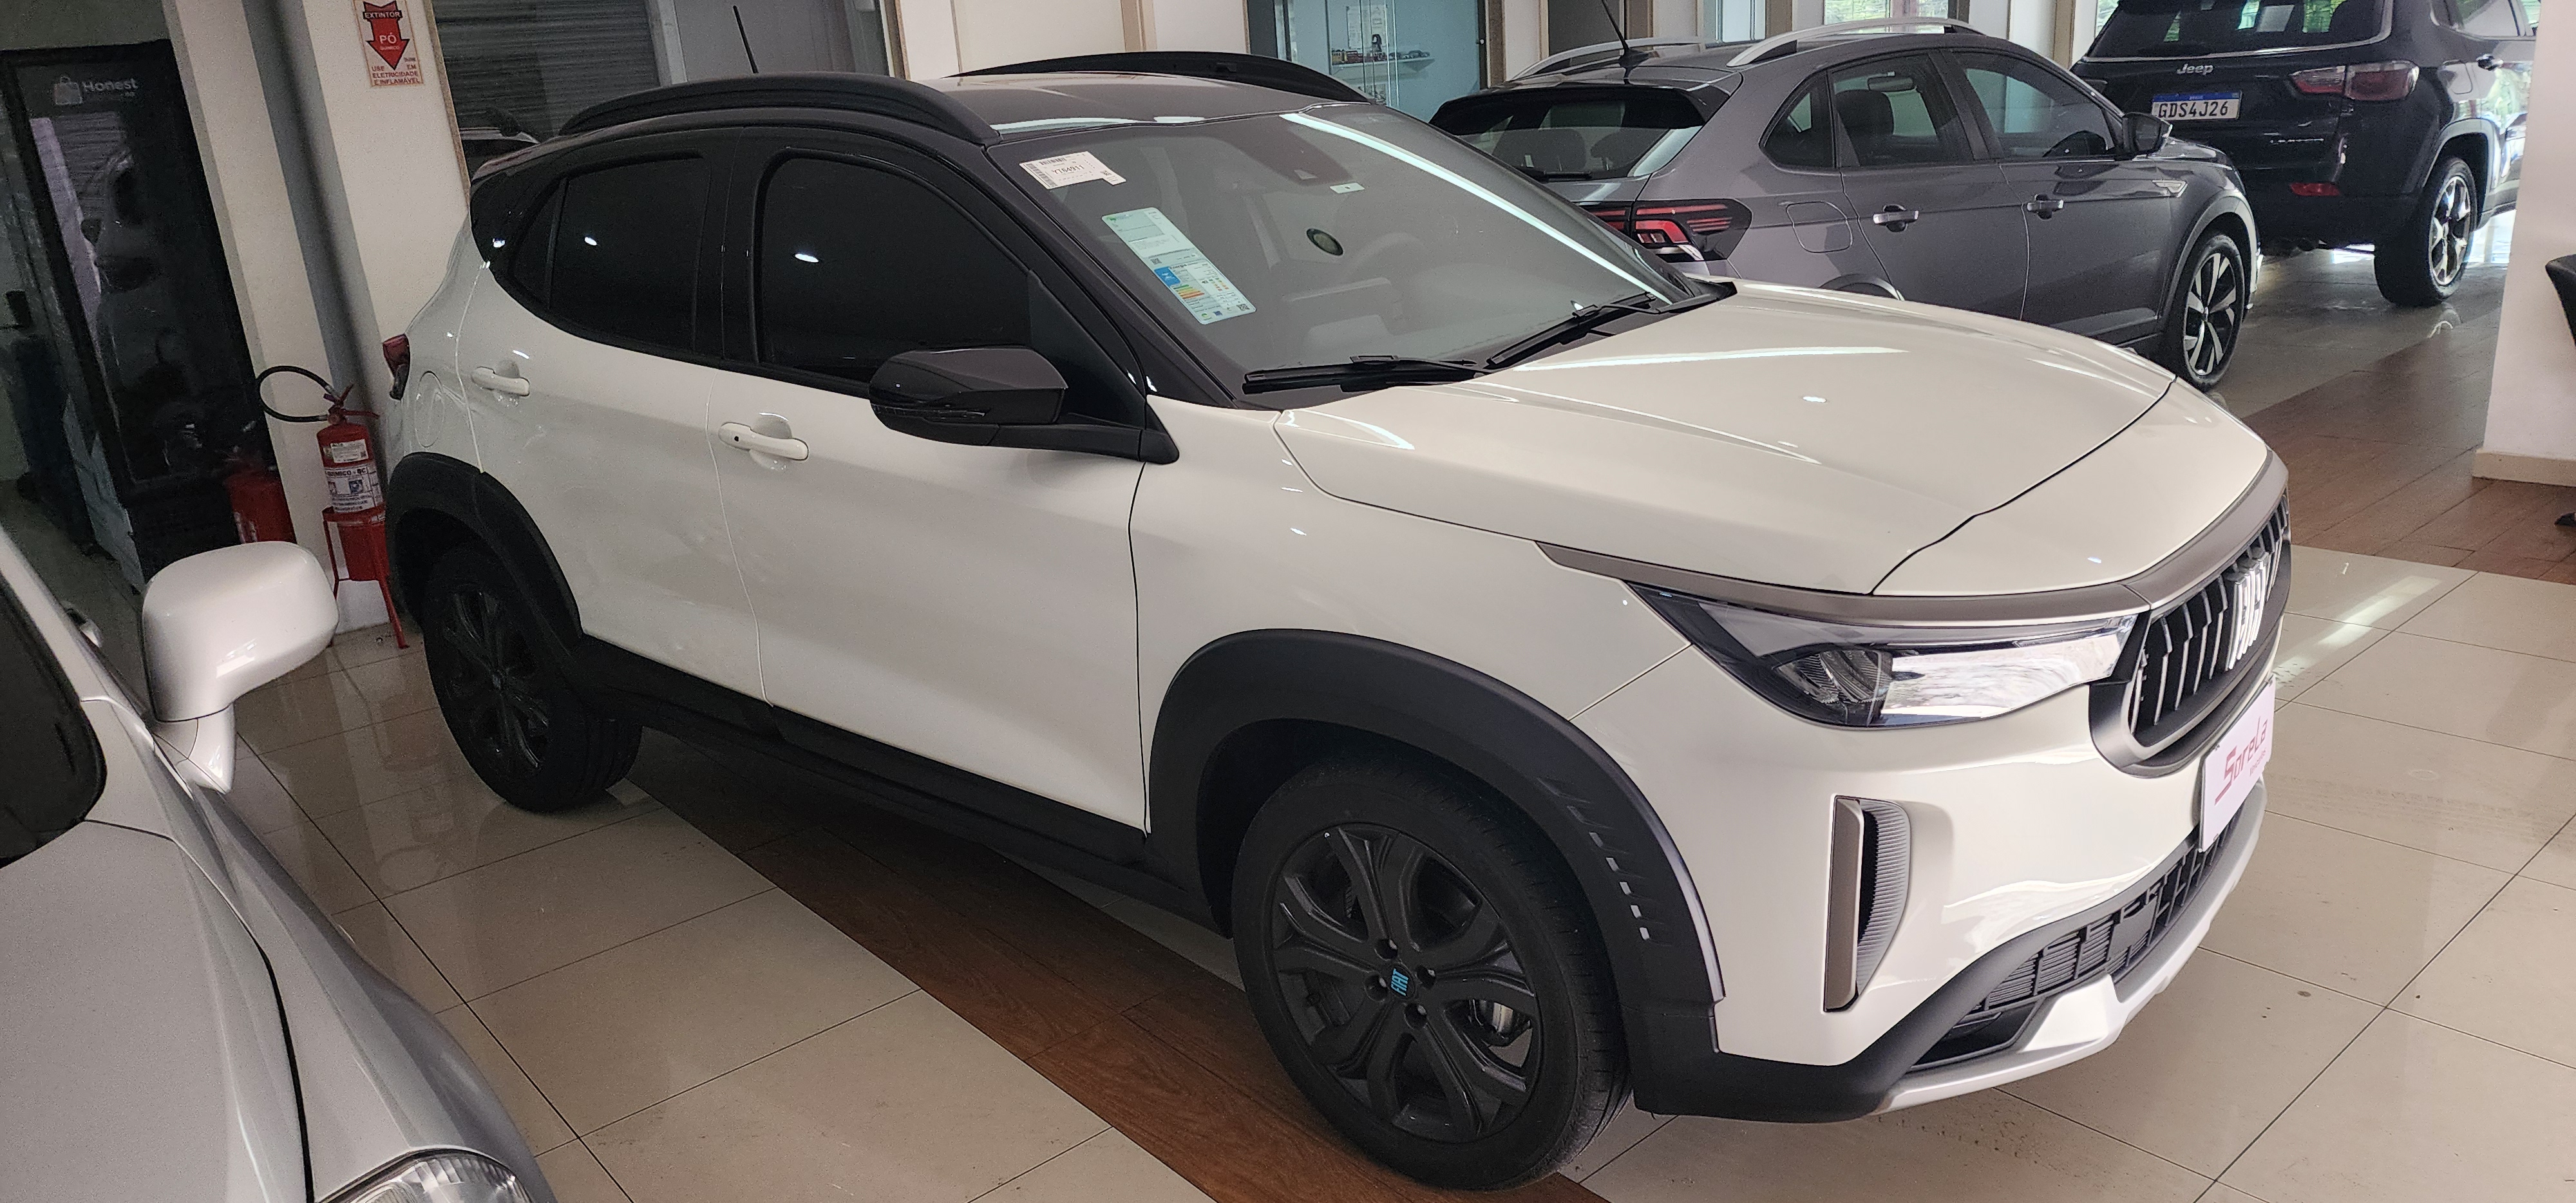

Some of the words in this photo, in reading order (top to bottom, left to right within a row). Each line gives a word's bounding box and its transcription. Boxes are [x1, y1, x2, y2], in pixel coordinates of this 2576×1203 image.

[379, 32, 397, 44] PÓ
[2176, 63, 2214, 76] Jeep
[81, 78, 138, 92] Honest
[2158, 100, 2229, 118] GDS4J26
[1390, 968, 1409, 997] FIAT
